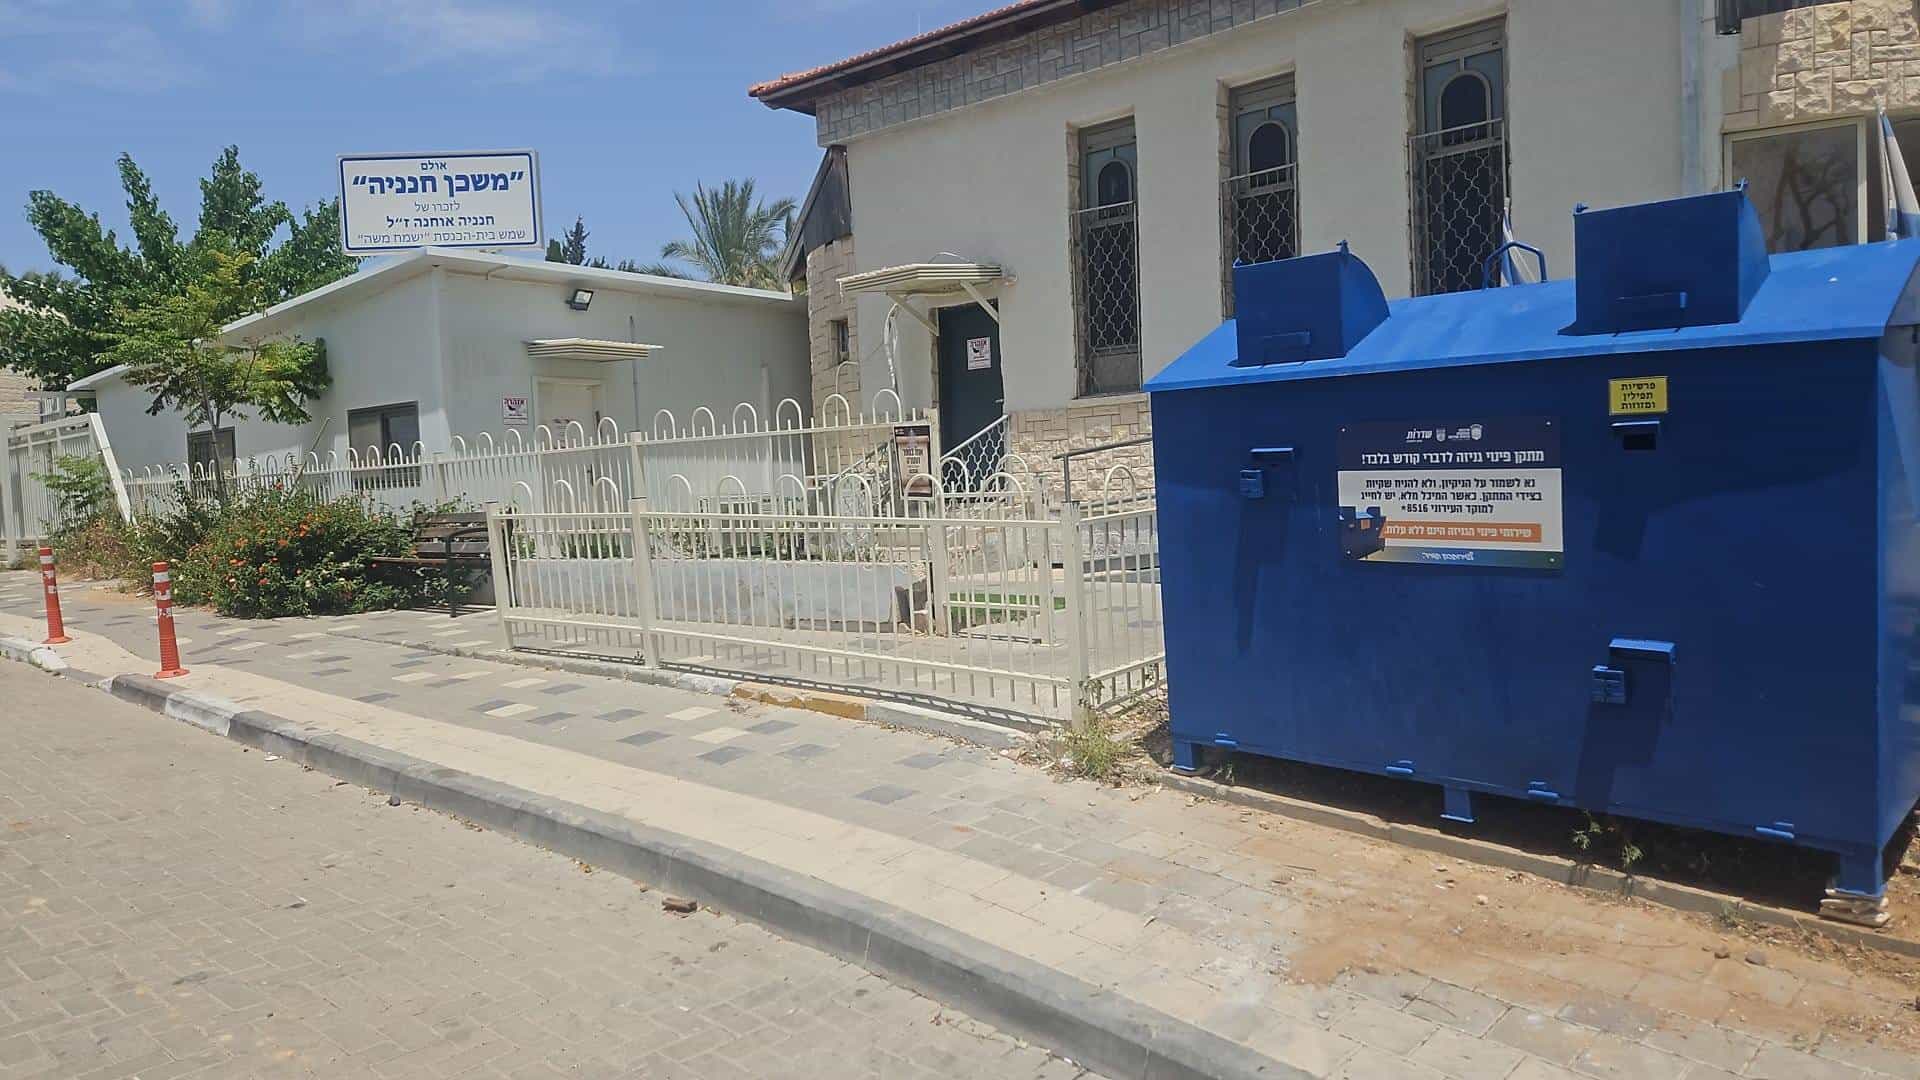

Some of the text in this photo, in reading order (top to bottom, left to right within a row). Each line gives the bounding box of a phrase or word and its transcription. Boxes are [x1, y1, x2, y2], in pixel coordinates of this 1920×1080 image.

[421, 160, 447, 171] אולם
[414, 200, 460, 212] לזכרו של
[414, 217, 454, 228] אוחנה
[458, 215, 495, 226] חנניה
[498, 230, 526, 240] שמש
[1620, 382, 1656, 391] פרשיות
[1623, 391, 1653, 401] תפילין
[1620, 401, 1656, 410] ומזוזות
[1361, 450, 1545, 465] מתקן פינוי גניזה לדברי קודש בלבד!
[1366, 479, 1392, 489] שקיות
[1394, 478, 1419, 489] להניח
[1421, 478, 1437, 488] ולא
[1473, 478, 1487, 488] על
[1489, 477, 1521, 488] לשמור
[1523, 478, 1536, 488] נא
[1360, 490, 1382, 500] לחייג
[1384, 491, 1396, 501] יש
[1420, 491, 1448, 501] המיכל
[1449, 491, 1477, 501] כאשר
[1515, 491, 1542, 501] בצידי
[1430, 504, 1463, 513] העירוני
[1465, 503, 1494, 515] למוקד
[1408, 525, 1425, 535] ללא
